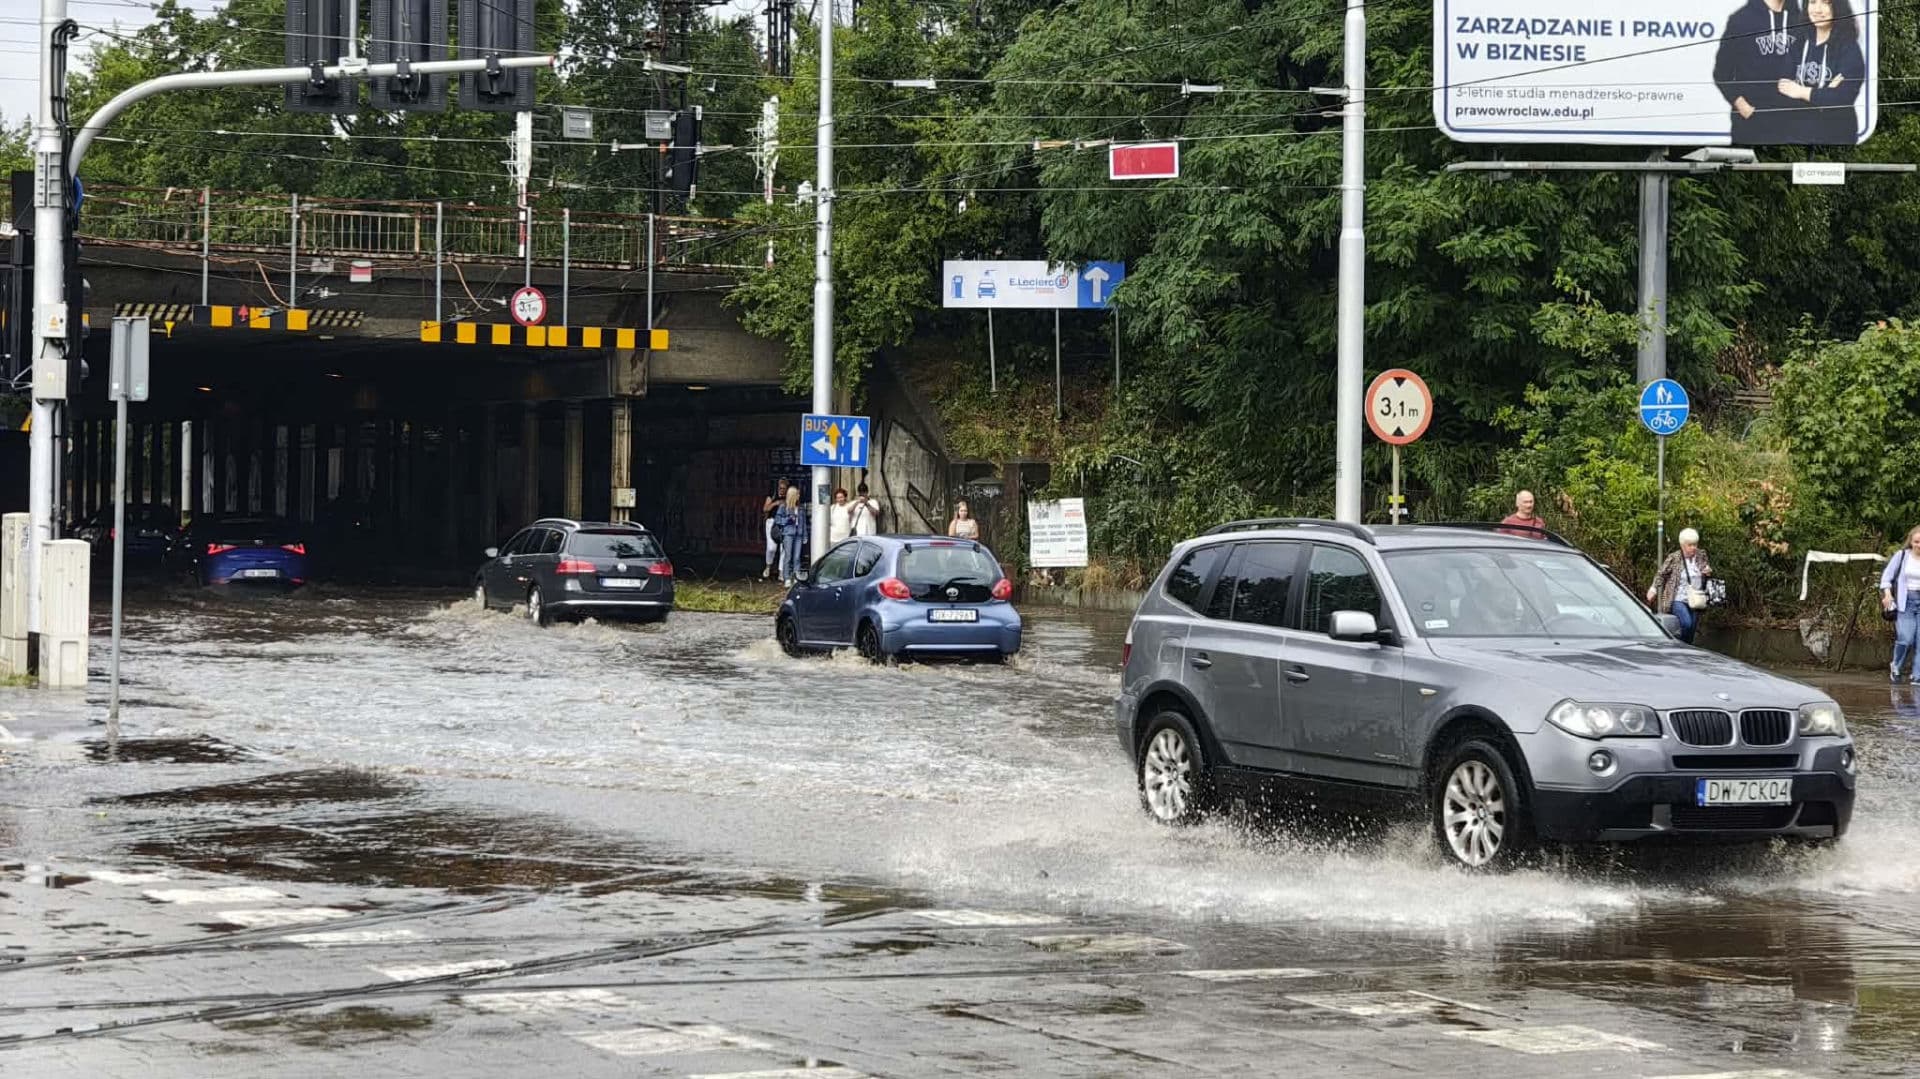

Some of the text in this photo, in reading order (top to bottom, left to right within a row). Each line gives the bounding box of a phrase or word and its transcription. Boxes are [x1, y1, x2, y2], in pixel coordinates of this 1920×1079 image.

[1456, 17, 1715, 39] ZARZĄDZANIE I PRAWO
[1457, 43, 1586, 61] W BIZNESIE
[1456, 87, 1504, 98] 3-letnie
[1507, 89, 1546, 99] studia
[1455, 106, 1594, 119] prawowroclaw.edu.pl
[1380, 397, 1418, 418] 3,1 m
[805, 418, 828, 432] BUS
[1709, 781, 1788, 801] DW 7CK04
